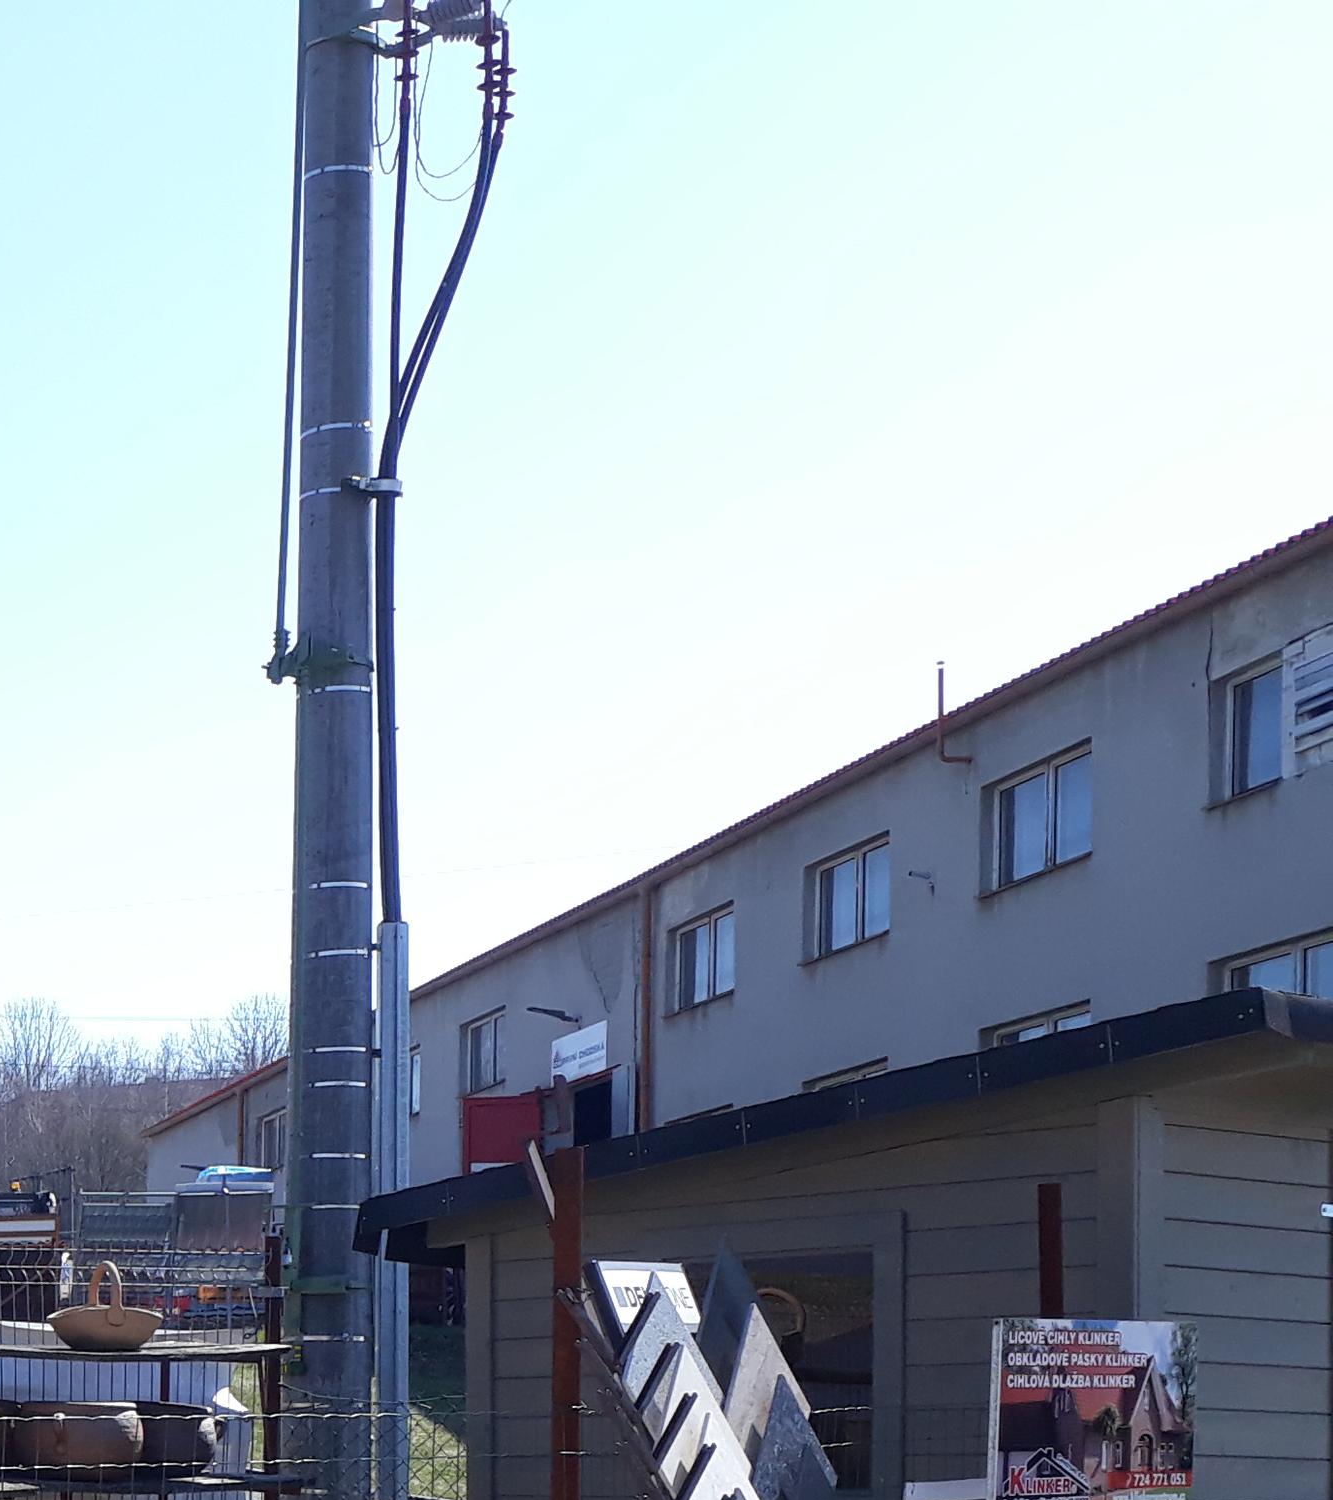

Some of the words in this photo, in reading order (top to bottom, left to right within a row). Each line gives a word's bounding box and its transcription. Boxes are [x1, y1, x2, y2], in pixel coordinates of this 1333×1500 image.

[1047, 1330, 1076, 1344] CIHLY
[1078, 1330, 1121, 1345] KLINKER
[1007, 1350, 1069, 1366] OBKLADOVÉ
[1071, 1350, 1104, 1367] PÁSKY
[1105, 1353, 1148, 1367] KLINKER
[1007, 1371, 1050, 1388] CIHLOVÁ
[1052, 1370, 1091, 1388] DLAŽBA
[1092, 1374, 1136, 1388] KLINKER
[1010, 1467, 1071, 1495] KLINKER
[1134, 1473, 1150, 1487] 724
[1152, 1473, 1168, 1486] 771
[1170, 1472, 1186, 1485] 051
